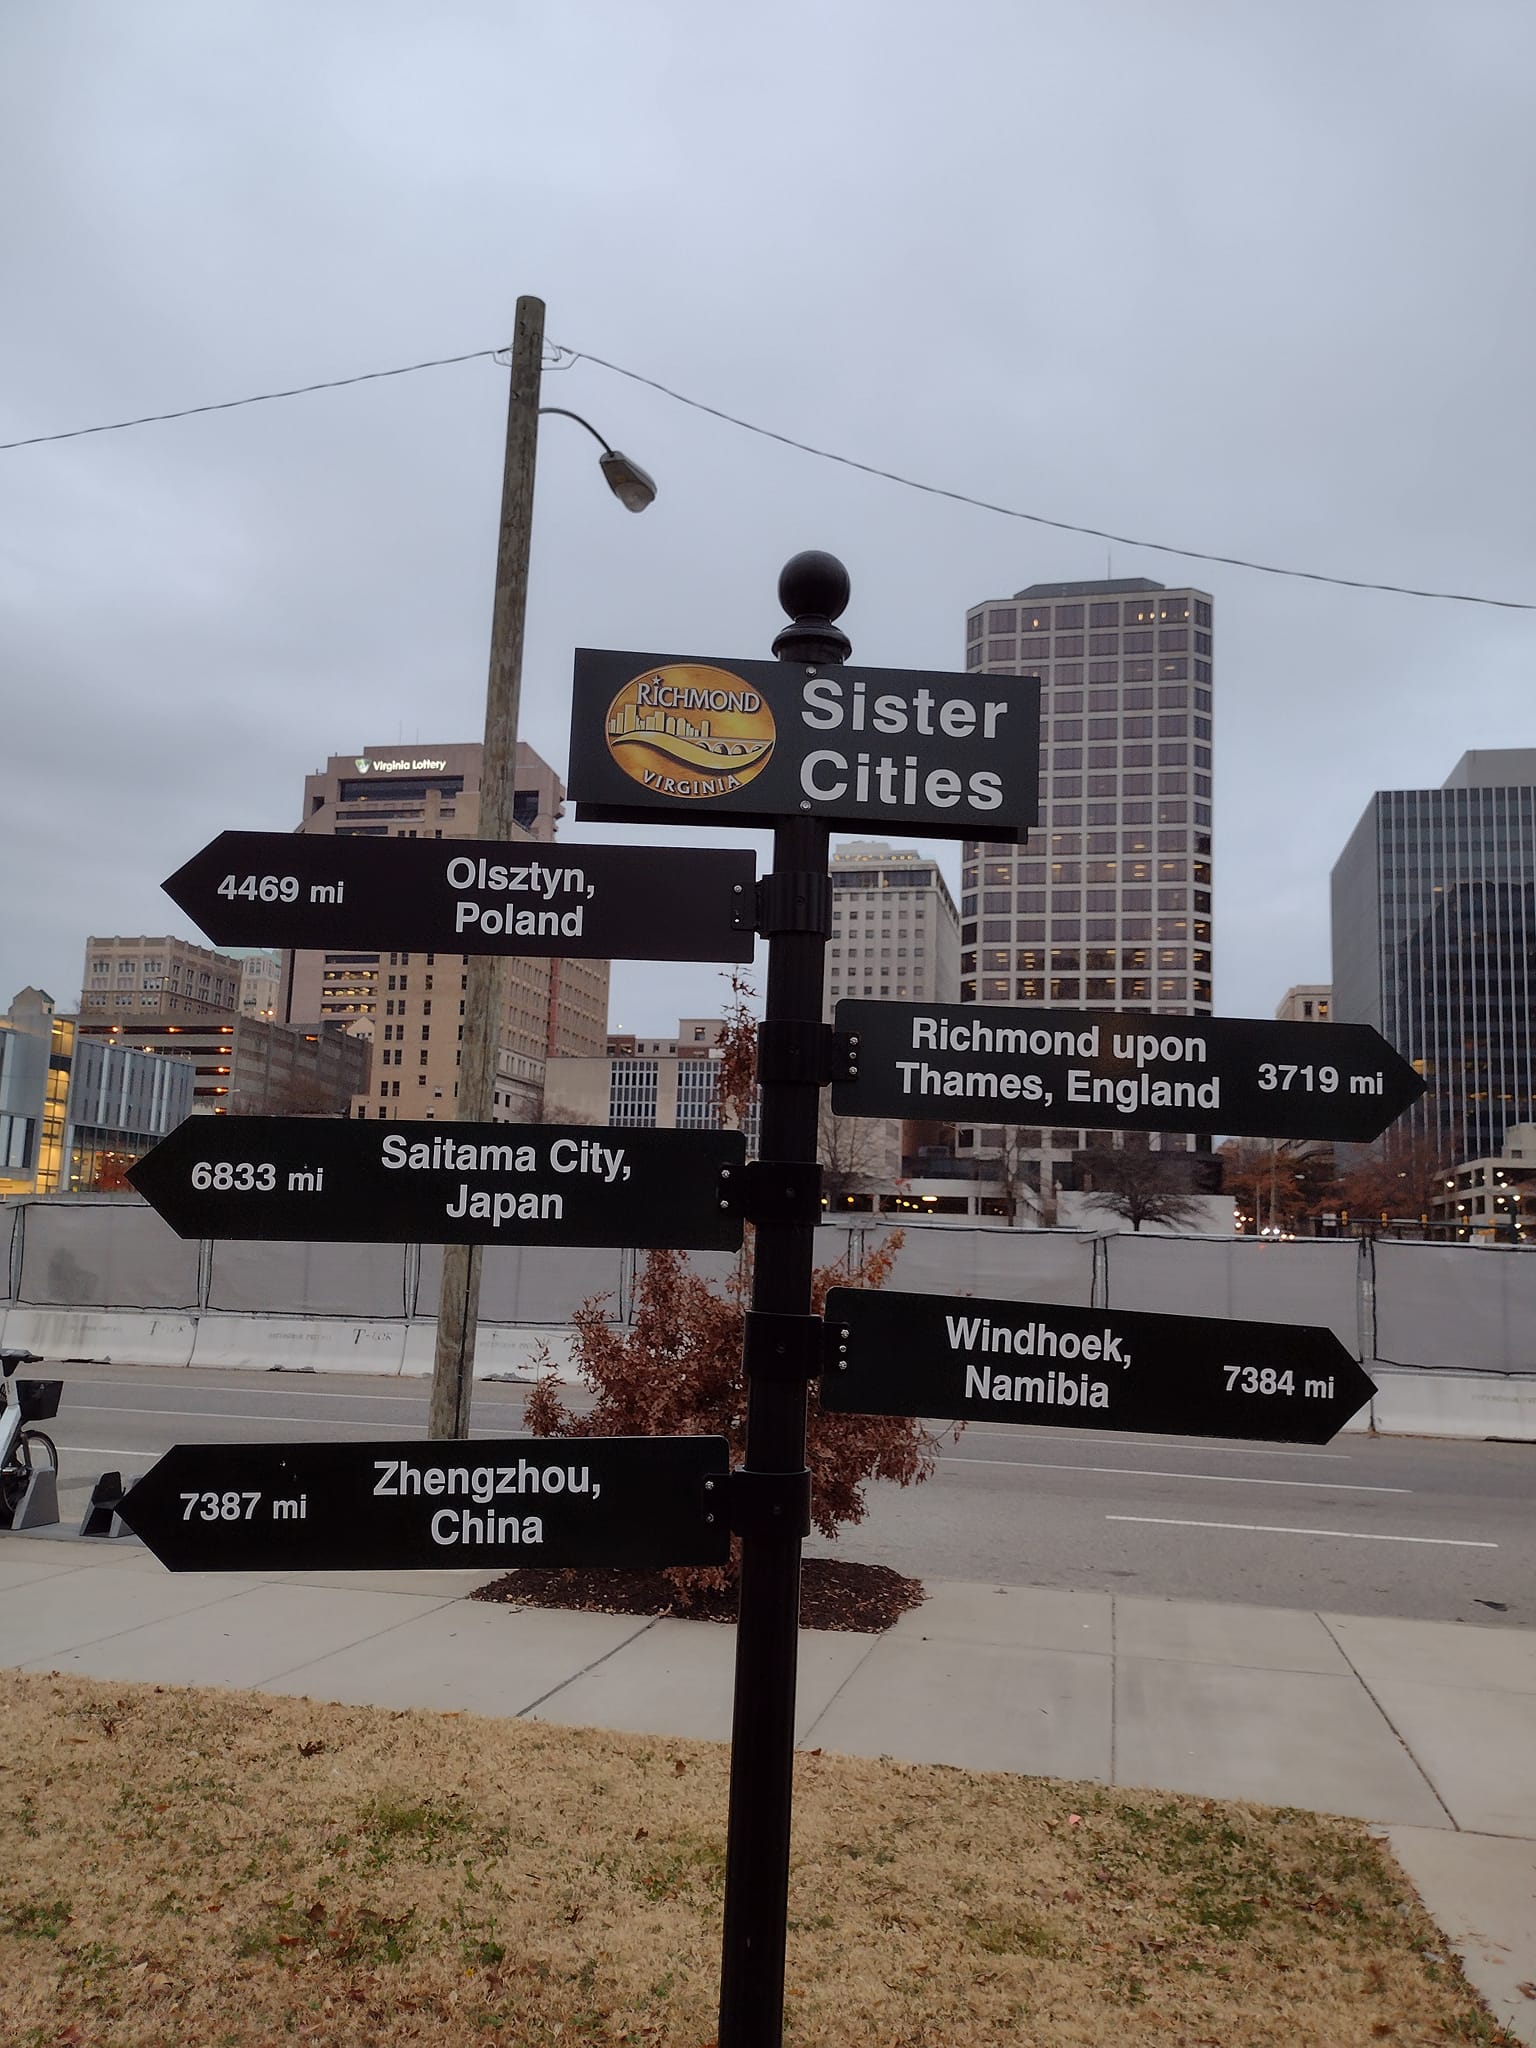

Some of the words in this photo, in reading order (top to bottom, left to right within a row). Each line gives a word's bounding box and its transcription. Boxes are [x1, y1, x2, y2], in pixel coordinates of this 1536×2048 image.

[801, 678, 1008, 739] Sister
[373, 760, 410, 773] Virginia
[412, 759, 447, 772] Lottery
[643, 768, 742, 795] VIRGINIA
[800, 749, 1003, 810] Cities
[217, 874, 300, 903] 4469
[310, 880, 344, 904] mi
[446, 856, 595, 900] Olsztyn,
[455, 901, 584, 937] Poland
[912, 1016, 1100, 1058] Richmond
[1112, 1034, 1207, 1068] upon
[895, 1061, 1053, 1107] Thames,
[1067, 1069, 1220, 1113] England
[1257, 1063, 1339, 1093] 3719
[1350, 1071, 1383, 1095] mi
[191, 1161, 276, 1191] 6833
[287, 1167, 324, 1192] mi
[381, 1134, 537, 1172] Saitama
[549, 1138, 631, 1183] City,
[446, 1184, 563, 1228] Japan
[945, 1315, 1131, 1370] Windhoek,
[965, 1364, 1110, 1408] Namibia
[1223, 1365, 1295, 1396] 7384
[1304, 1376, 1335, 1399] mi
[373, 1458, 601, 1504] Zhengzhou,
[179, 1491, 262, 1521] 7387
[273, 1493, 307, 1520] mi
[431, 1508, 544, 1545] China
